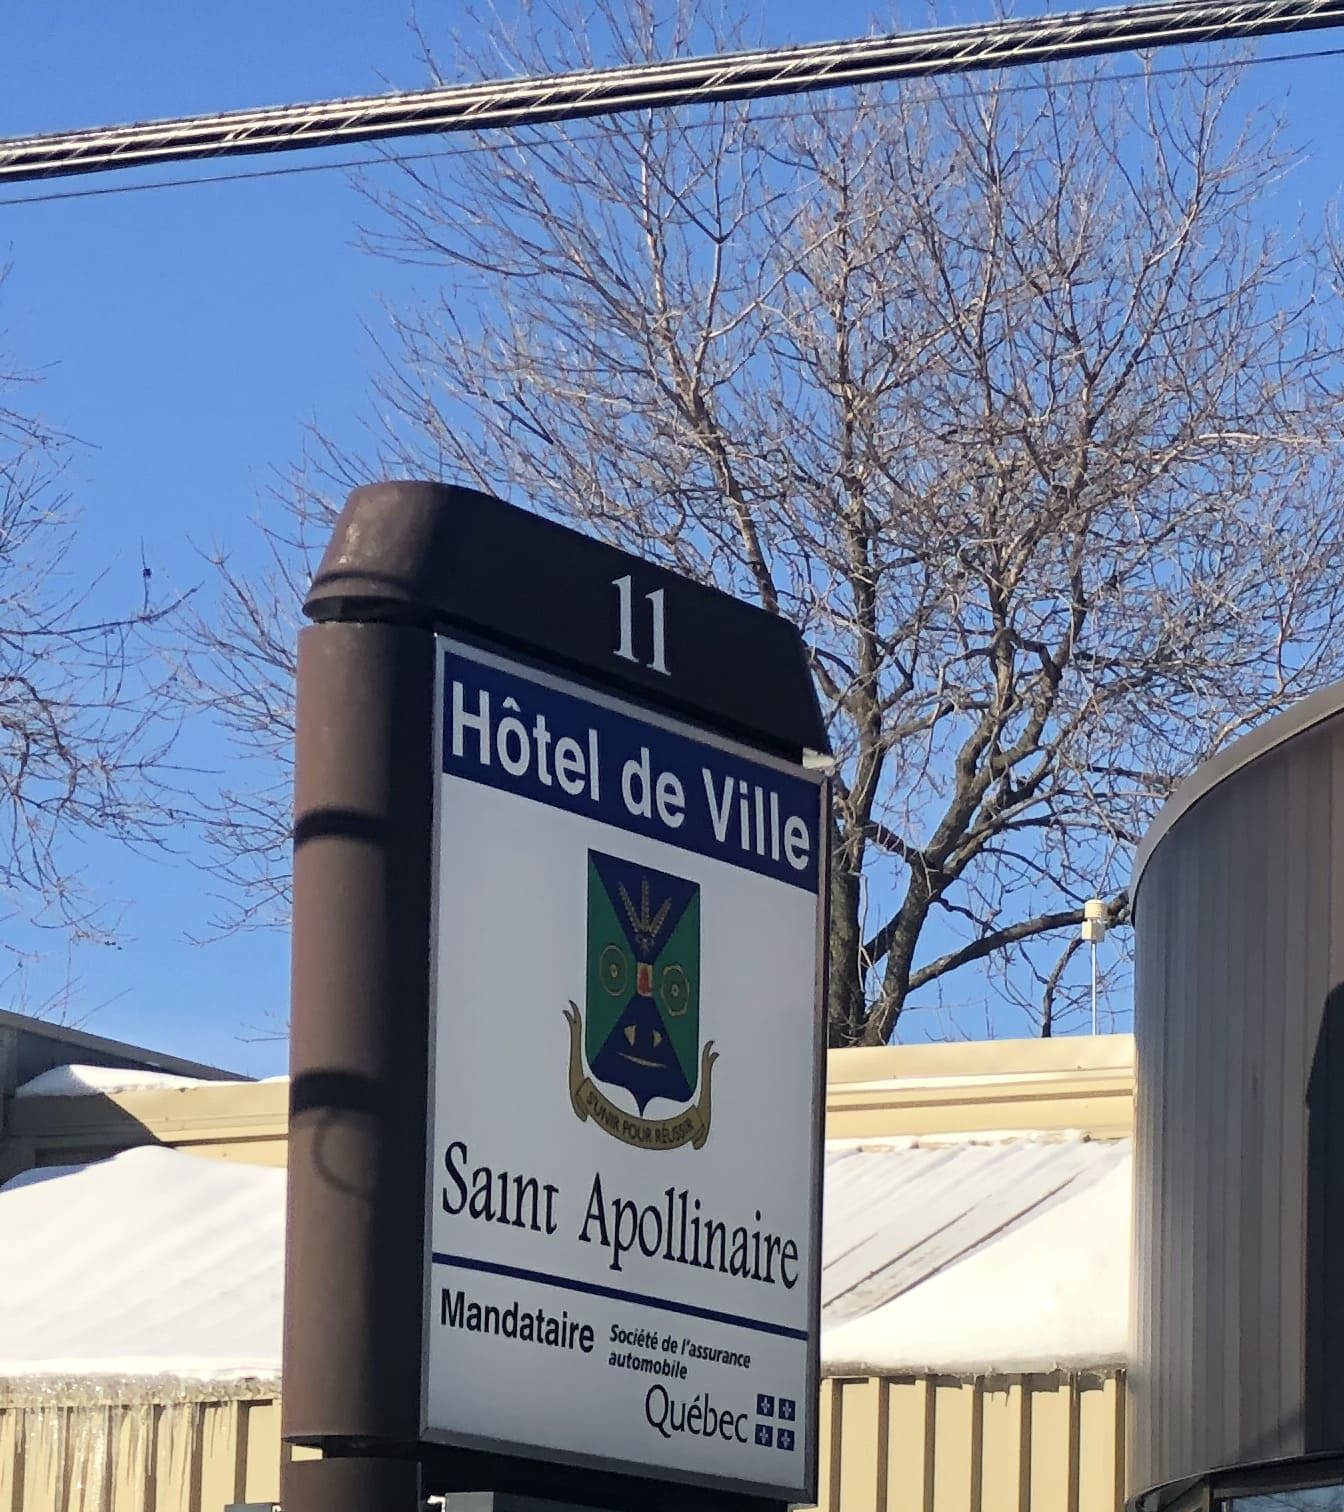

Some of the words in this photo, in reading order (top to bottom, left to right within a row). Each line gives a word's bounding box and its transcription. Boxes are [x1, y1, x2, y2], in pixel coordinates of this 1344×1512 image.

[611, 574, 671, 677] 11
[452, 680, 600, 802] Hôtel
[621, 747, 686, 828] de
[702, 767, 810, 870] Ville
[622, 1121, 653, 1143] POUR
[442, 1141, 560, 1236] Saint
[578, 1171, 799, 1290] Apollinaire
[440, 1287, 595, 1354] Mandataire
[609, 1323, 659, 1351] Société
[661, 1335, 679, 1354] de
[681, 1338, 752, 1370] l'assurance
[608, 1350, 688, 1380] automobile
[645, 1383, 749, 1444] Québec
